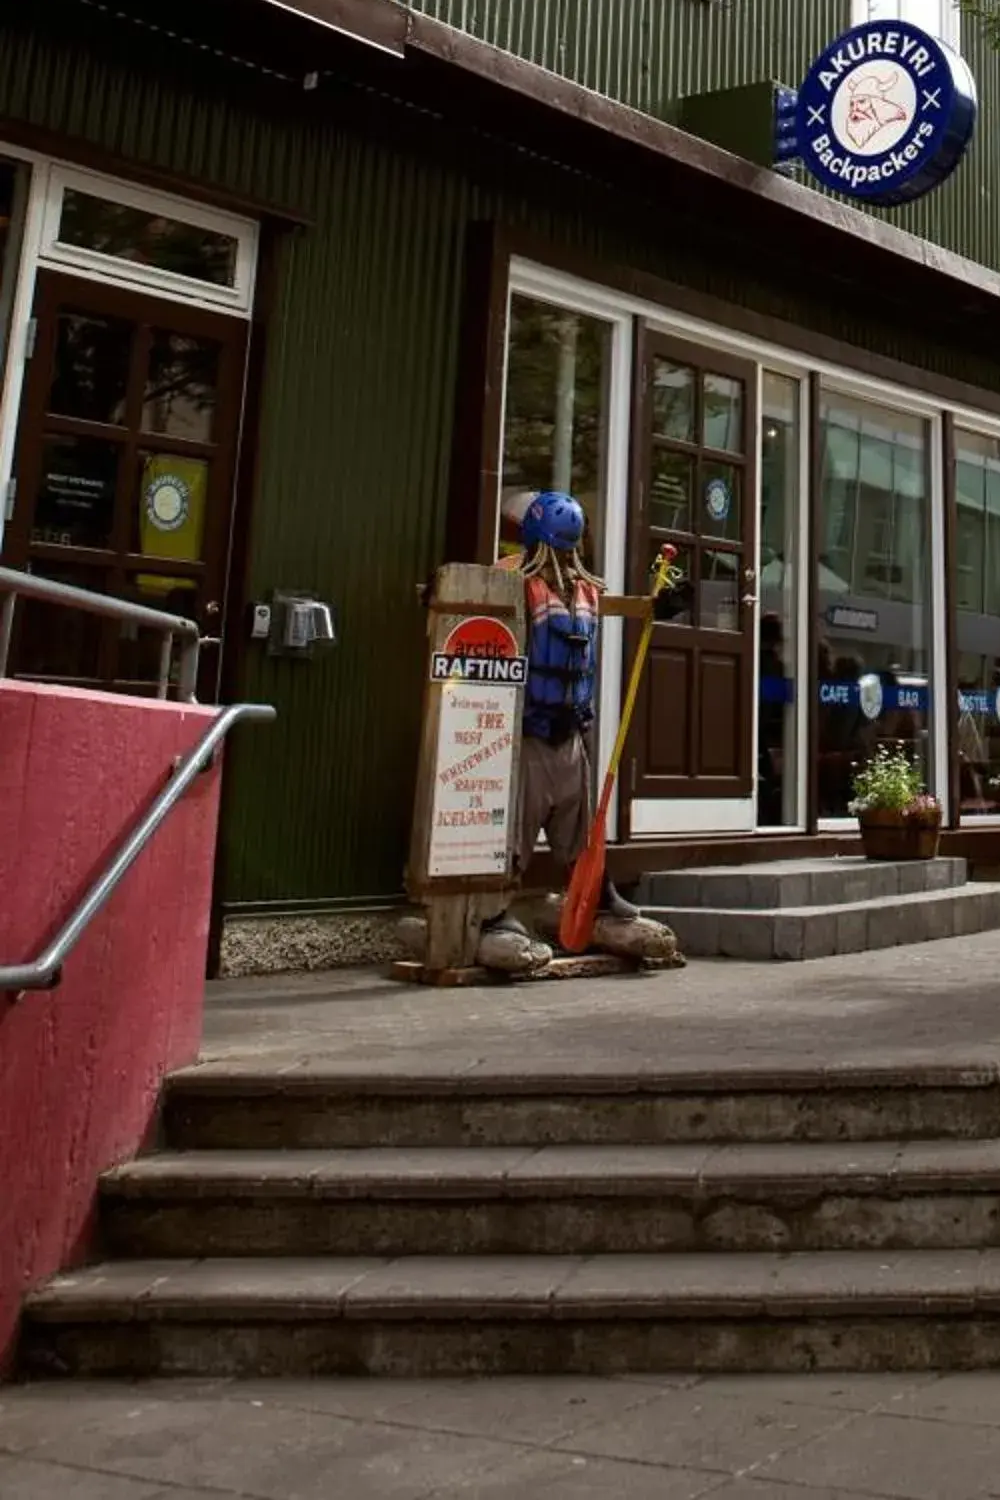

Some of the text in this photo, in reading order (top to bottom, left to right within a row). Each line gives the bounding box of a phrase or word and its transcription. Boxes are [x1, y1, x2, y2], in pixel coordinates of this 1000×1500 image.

[811, 121, 934, 188] Backpackers
[434, 656, 524, 681] RAFTING
[820, 683, 919, 707] CAFE BAR
[476, 713, 505, 730] THE
[454, 731, 483, 745] BEST
[454, 778, 504, 792] RAFTING
